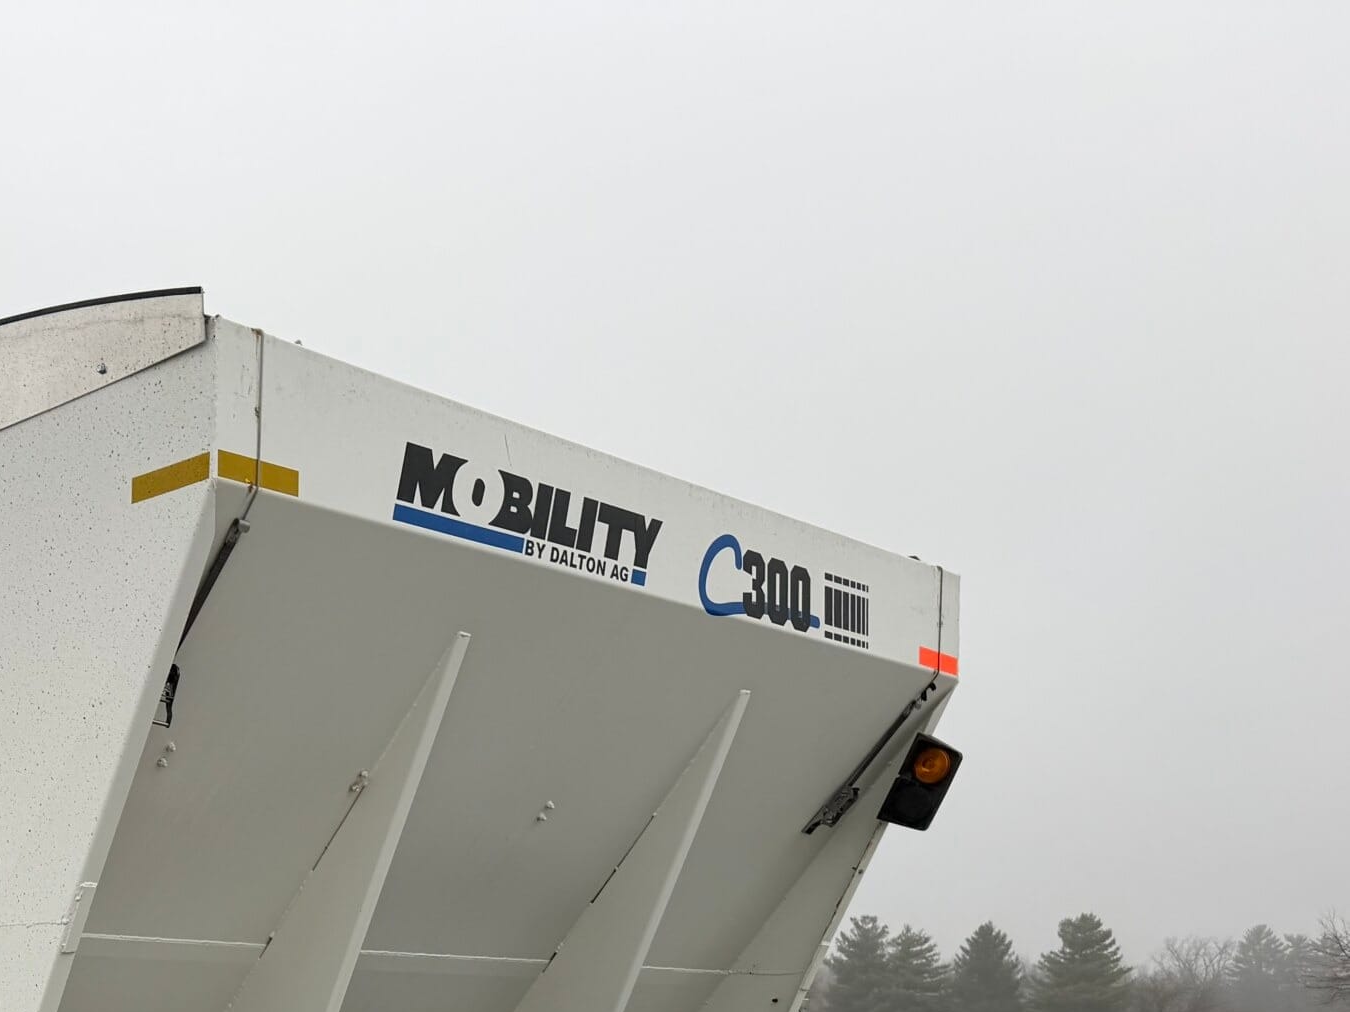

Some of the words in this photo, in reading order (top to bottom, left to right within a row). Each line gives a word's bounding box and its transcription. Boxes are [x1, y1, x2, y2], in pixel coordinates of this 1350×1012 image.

[396, 441, 663, 570] MOBILITY
[524, 539, 546, 559] BY
[550, 546, 607, 576] DALTON
[610, 564, 630, 582] AG
